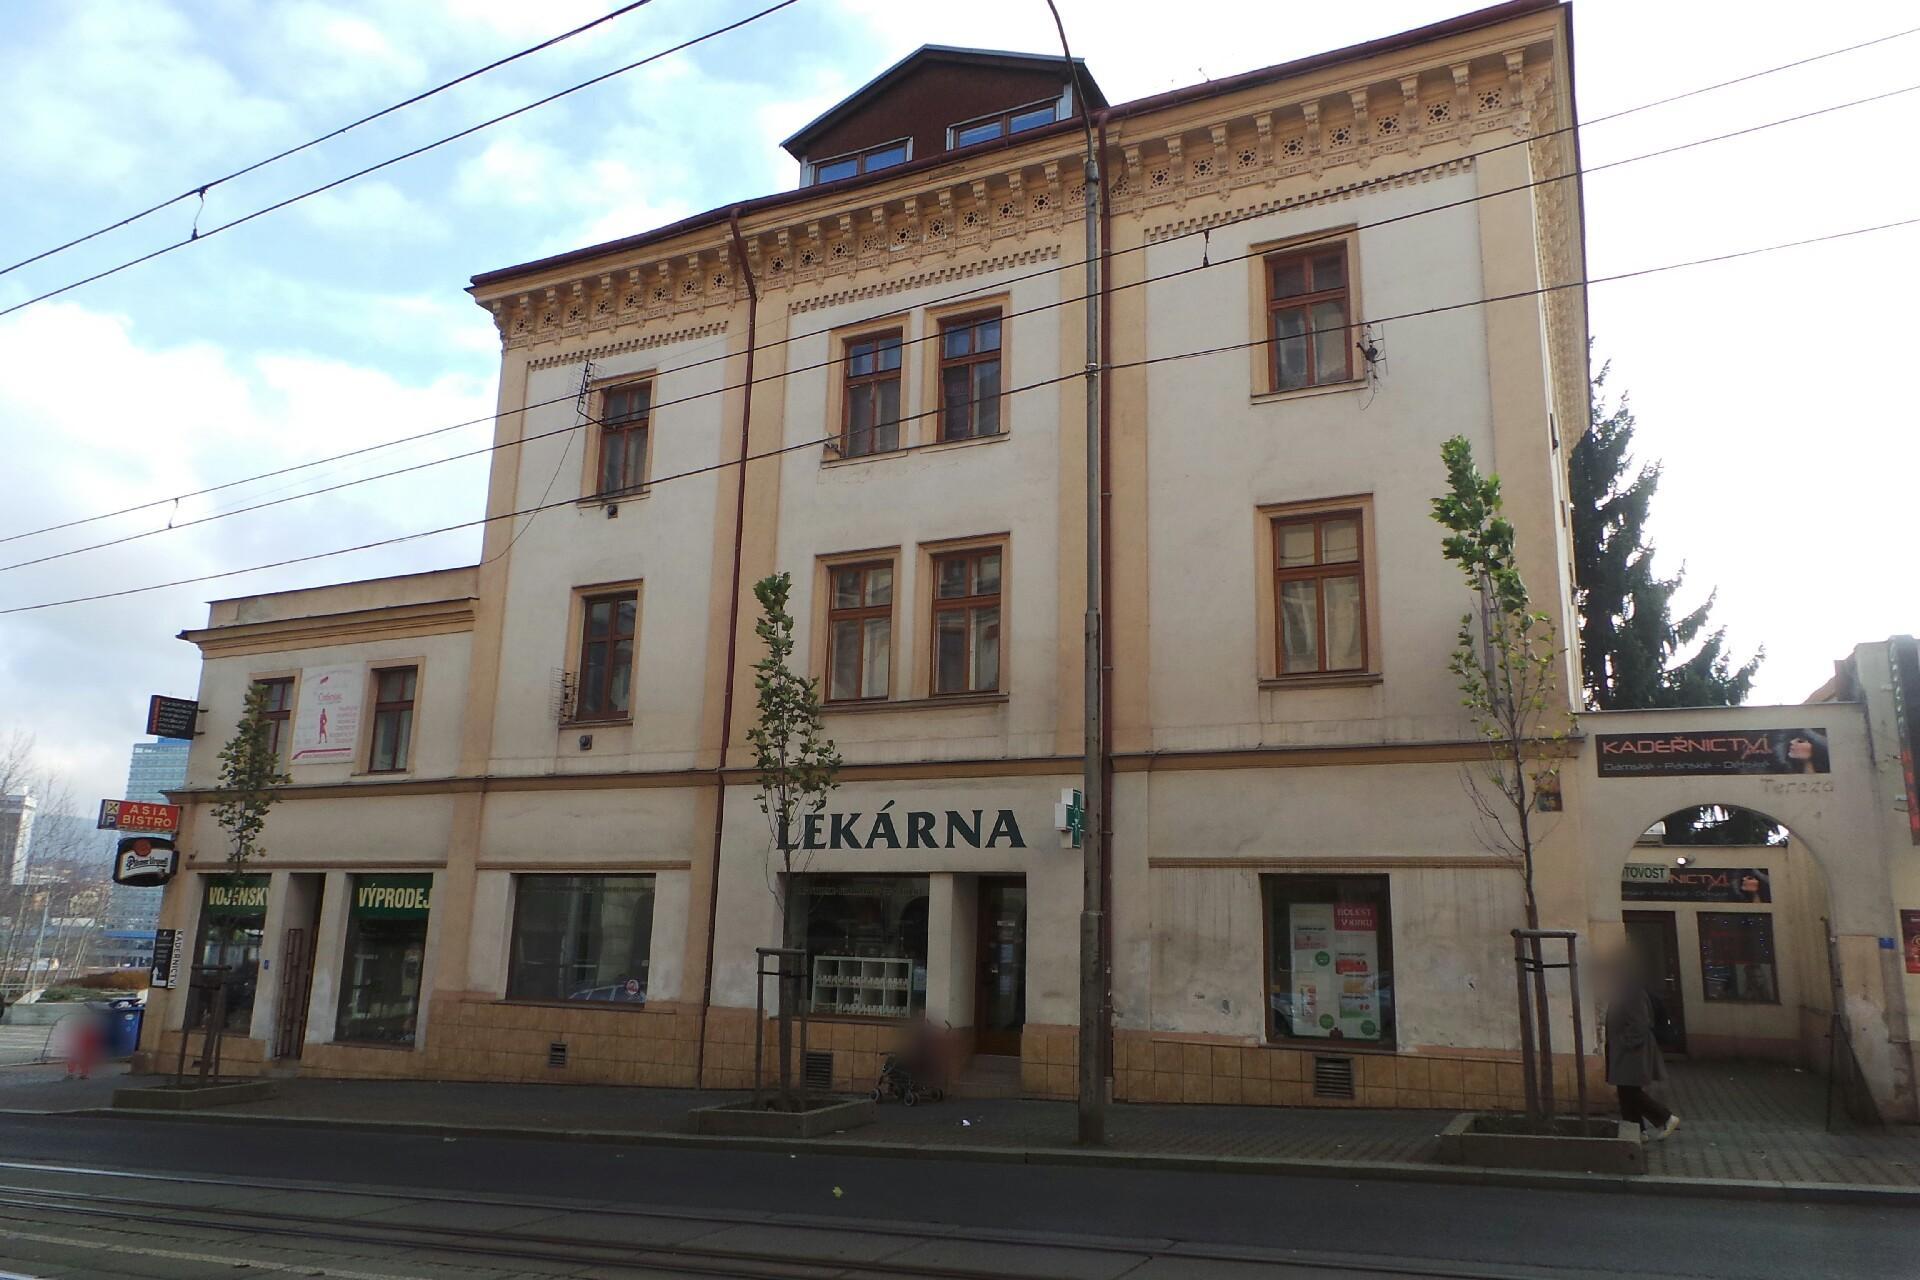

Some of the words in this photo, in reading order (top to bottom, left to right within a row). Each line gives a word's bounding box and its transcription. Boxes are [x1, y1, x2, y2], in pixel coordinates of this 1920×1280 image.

[1760, 778, 1833, 794] Tereza
[129, 804, 168, 817] ASIA
[122, 815, 172, 827] BISTRO
[776, 798, 1027, 850] LÉKÁRNA
[1623, 866, 1665, 879] TOVOST
